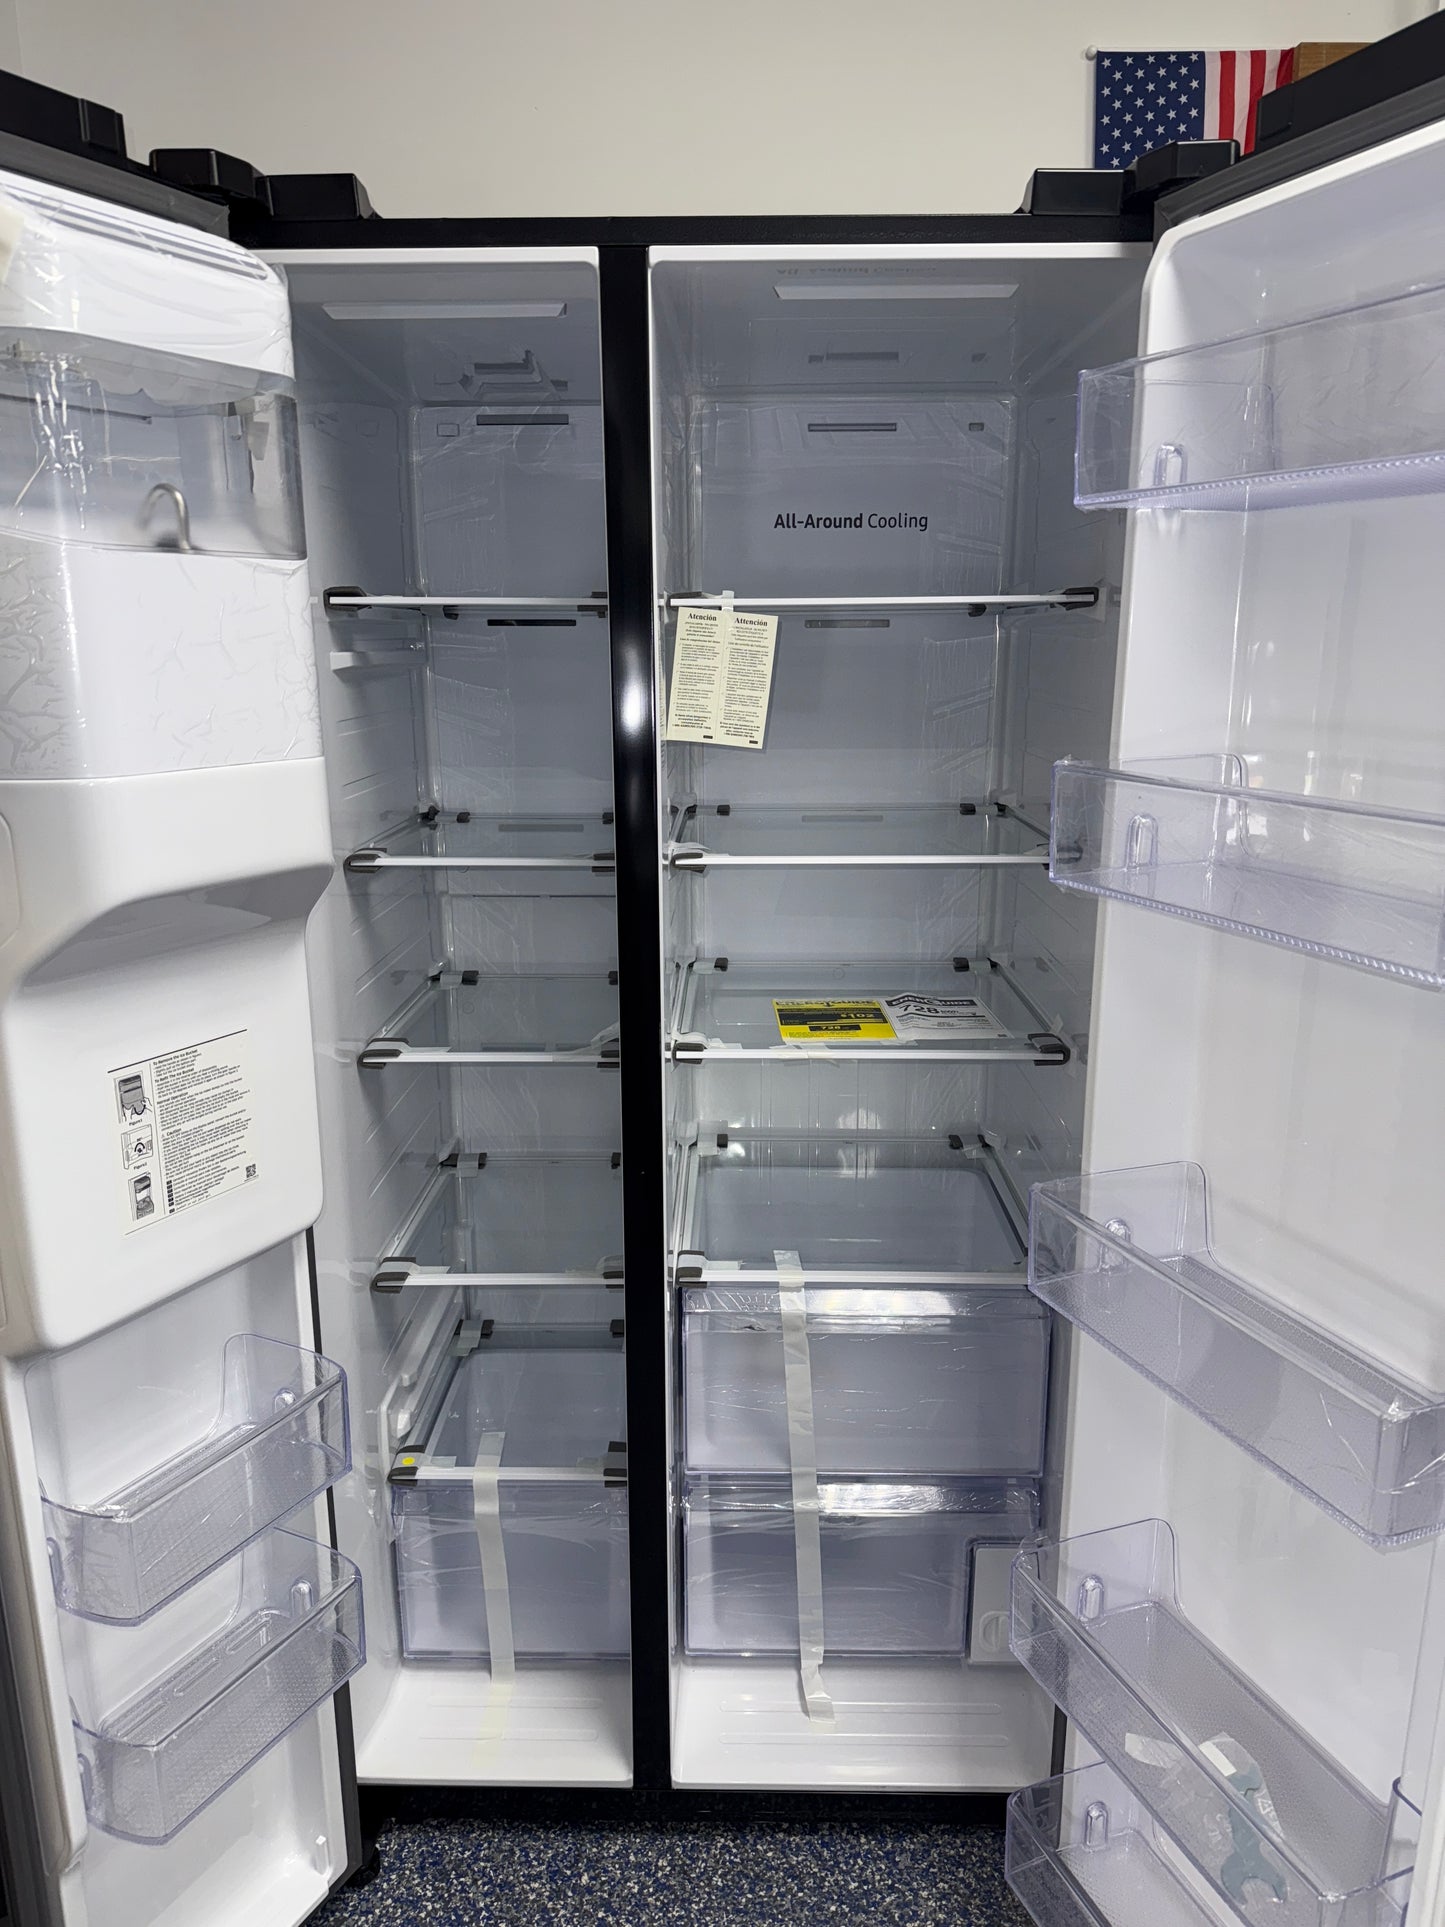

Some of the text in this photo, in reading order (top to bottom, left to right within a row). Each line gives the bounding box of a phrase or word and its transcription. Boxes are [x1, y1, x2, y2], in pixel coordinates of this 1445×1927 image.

[774, 513, 928, 532] All-Around Cooling
[688, 613, 717, 621] Atención
[900, 1005, 939, 1014] 728
